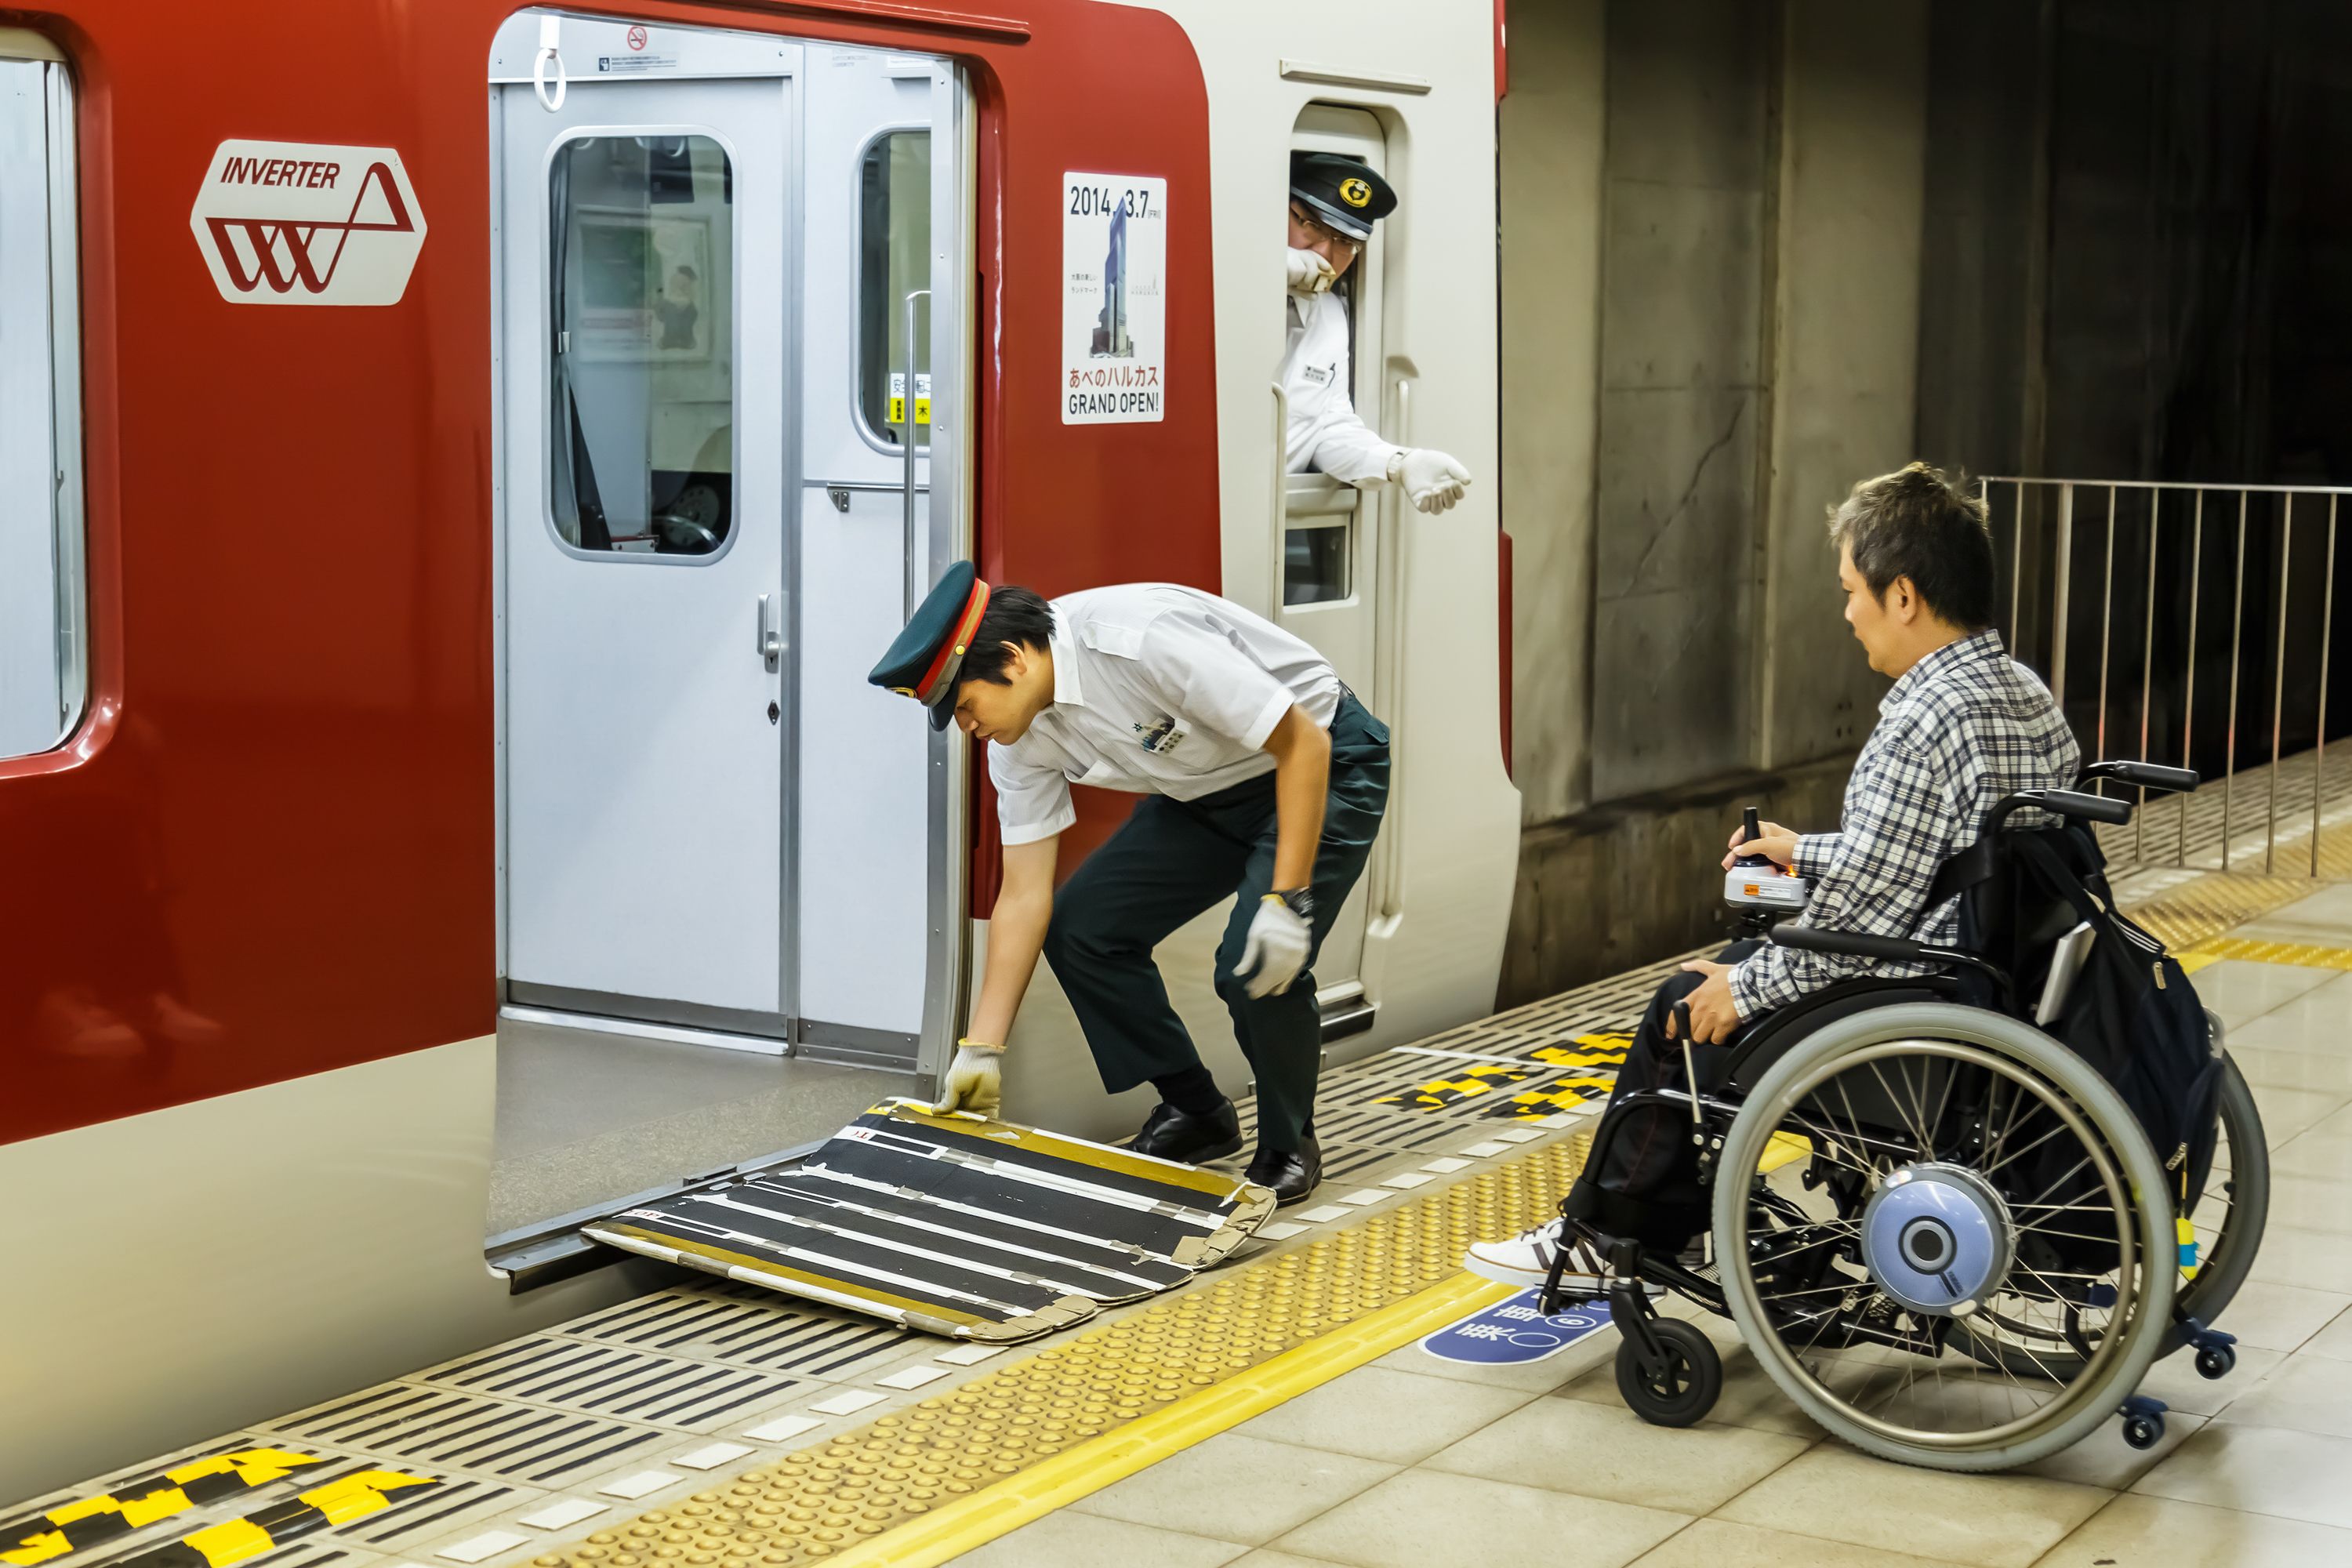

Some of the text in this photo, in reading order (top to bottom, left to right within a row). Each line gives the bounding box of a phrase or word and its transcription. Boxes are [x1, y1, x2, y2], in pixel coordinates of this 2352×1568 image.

[220, 157, 340, 189] INVERTER
[1069, 365, 1158, 388] あべのハルカス
[1069, 392, 1159, 414] GRAND OPEN!
